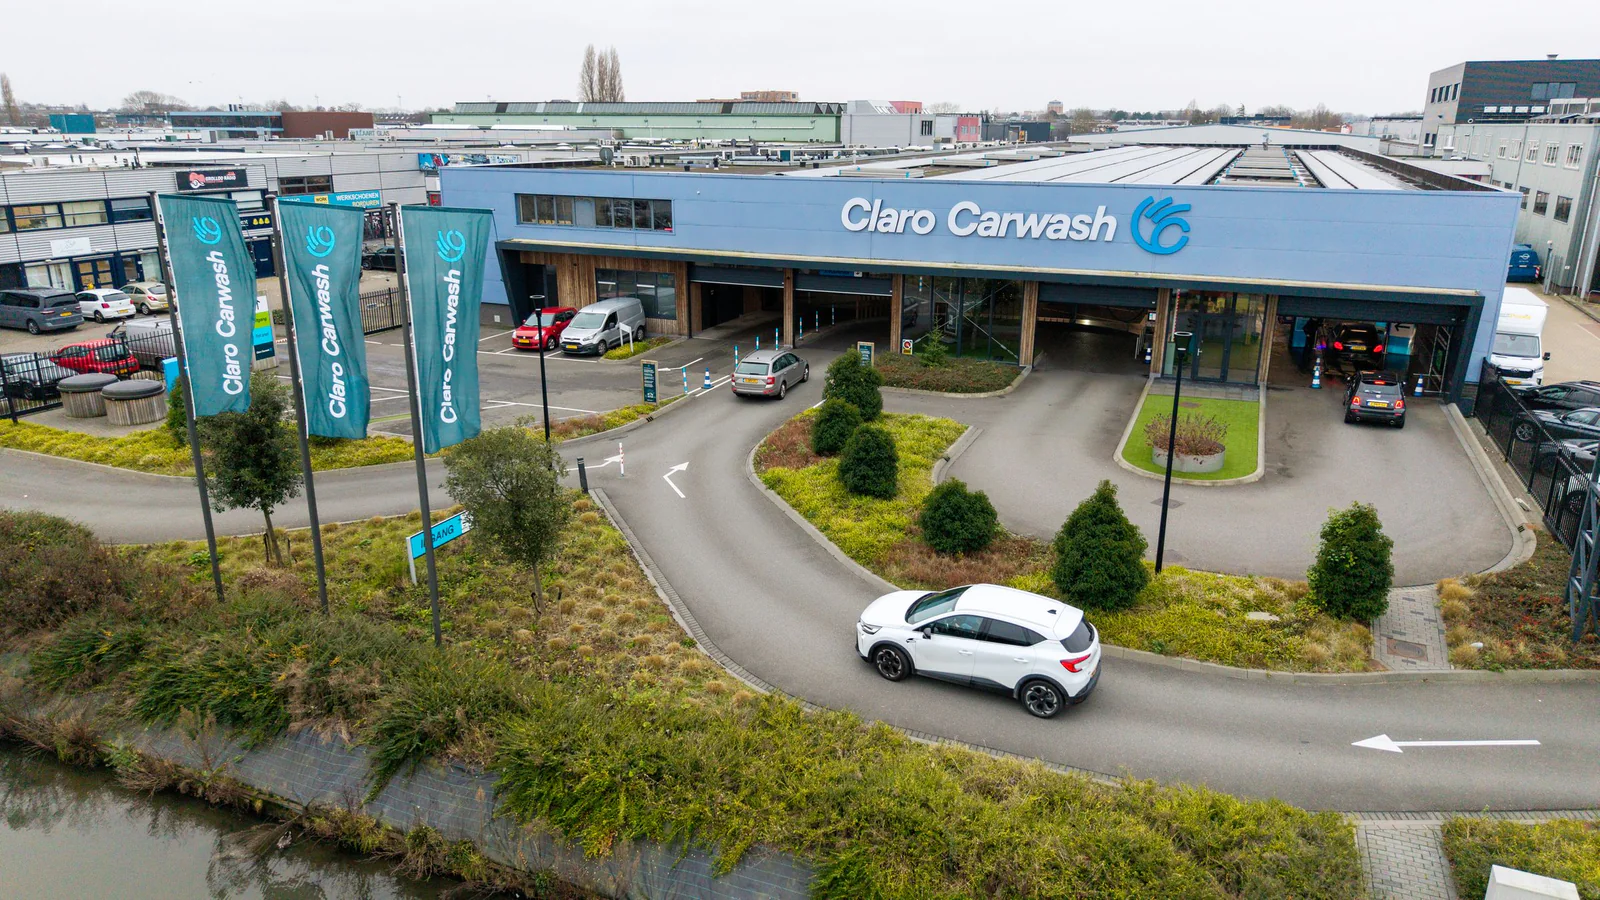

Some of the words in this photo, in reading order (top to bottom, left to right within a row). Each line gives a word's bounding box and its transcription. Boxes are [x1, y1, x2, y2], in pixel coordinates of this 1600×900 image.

[335, 191, 379, 201] WERKSCHOENEN
[841, 197, 937, 235] Claro
[948, 201, 1118, 242] Carwash
[206, 250, 236, 338] Carwash
[311, 263, 340, 356] Carwash
[443, 269, 461, 362] Carwash
[223, 343, 244, 395] Claro
[329, 362, 347, 418] Claro
[440, 368, 457, 424] Claro
[421, 524, 454, 549] IGANG
